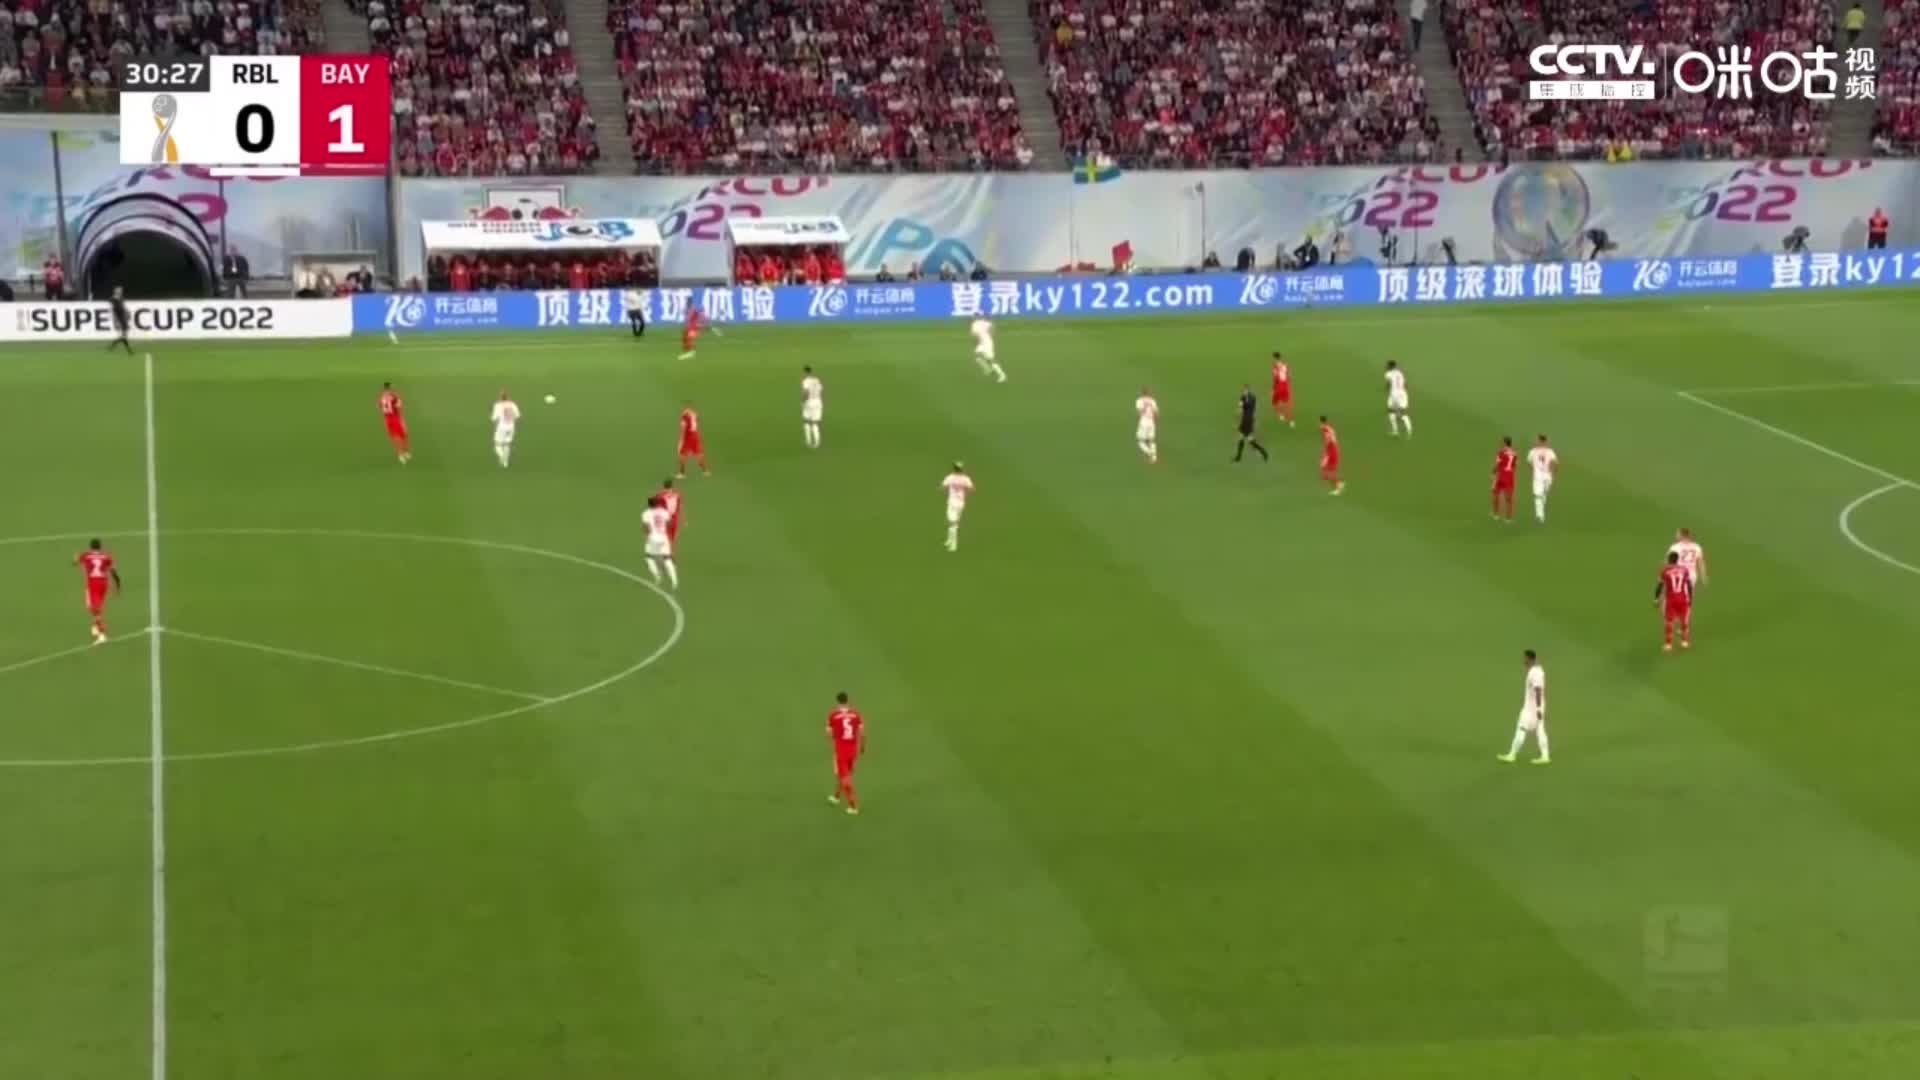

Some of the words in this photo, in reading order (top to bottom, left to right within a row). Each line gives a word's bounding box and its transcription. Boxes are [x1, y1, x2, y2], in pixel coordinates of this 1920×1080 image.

[1377, 260, 1603, 302] 顶级滚球体验
[951, 280, 1214, 316] 登录ky122.com
[31, 307, 195, 332] SUPECUP
[201, 306, 274, 329] 2022
[842, 718, 854, 740] 5
